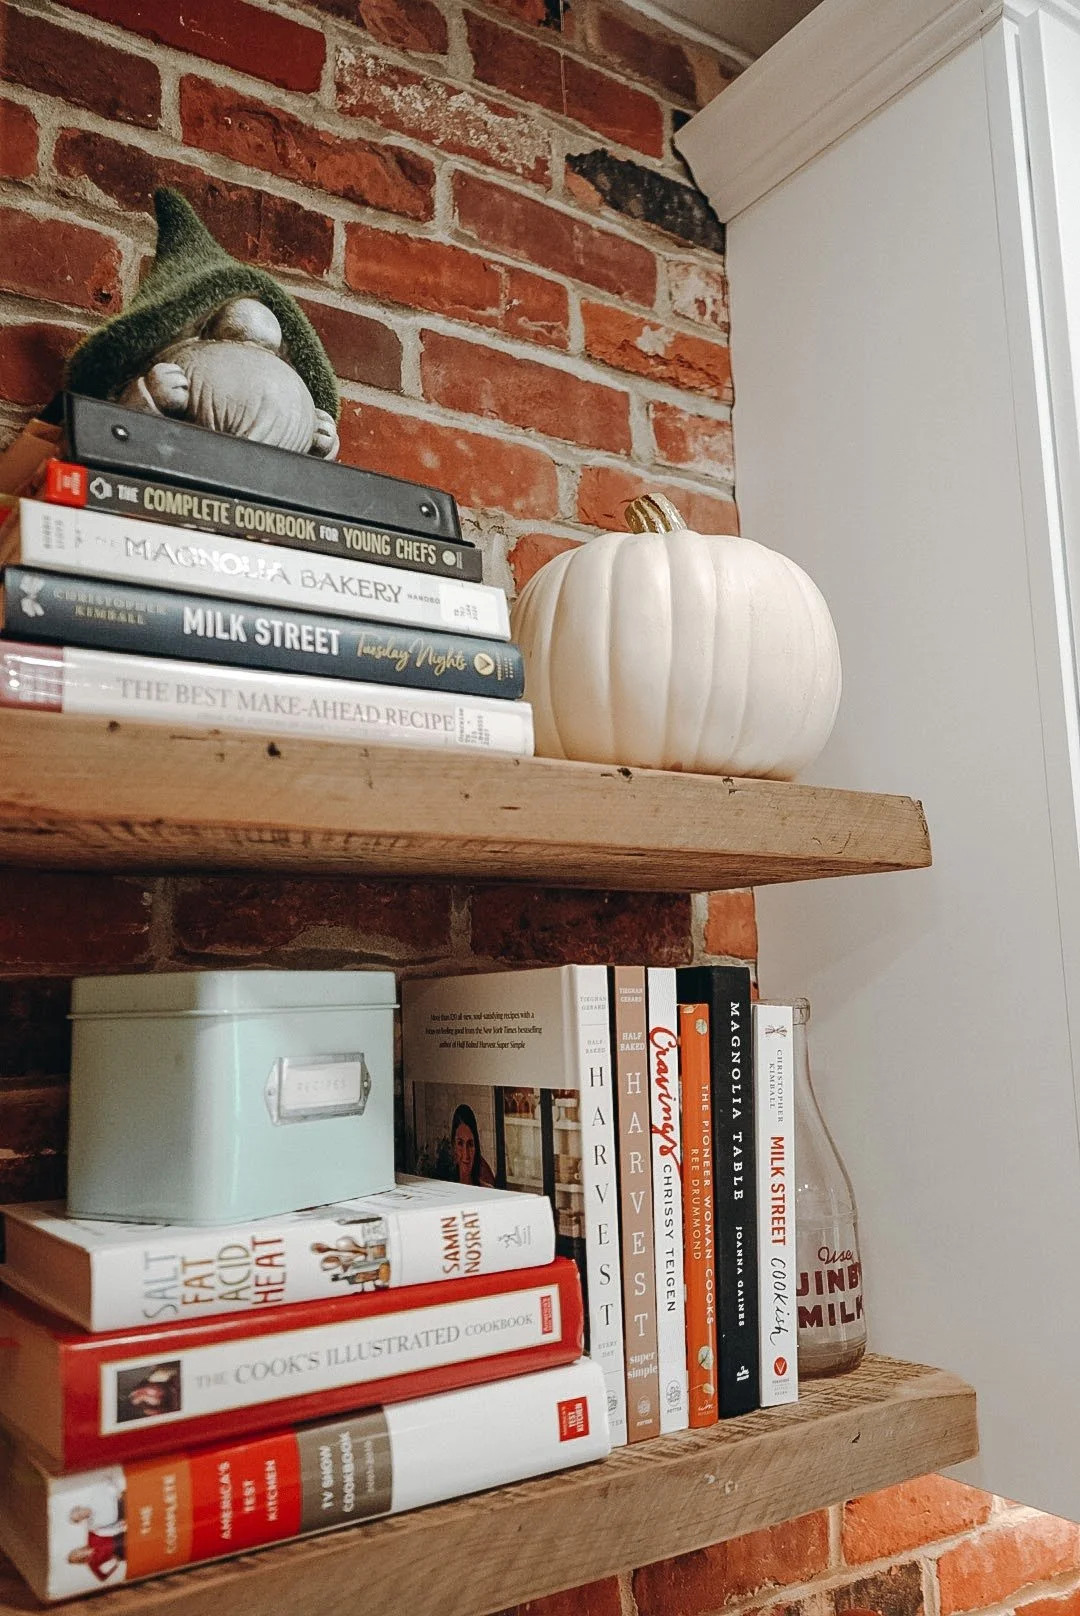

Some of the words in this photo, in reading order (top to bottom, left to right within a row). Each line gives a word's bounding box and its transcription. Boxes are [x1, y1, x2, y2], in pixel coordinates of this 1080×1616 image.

[117, 484, 139, 503] THE
[143, 486, 231, 526] COMPLETE
[234, 504, 317, 542] COOKBOOK
[319, 525, 339, 543] FOR
[342, 526, 391, 556] YOUNG
[396, 538, 437, 565] CHEFS
[125, 536, 292, 586] MAGNOLIA
[300, 569, 403, 605] BAKERY
[183, 606, 248, 643] MILK
[254, 617, 341, 656] STREET
[351, 631, 411, 672] Tuesday
[412, 637, 467, 676] Nights
[117, 677, 169, 701] THE
[176, 682, 231, 708] BEST
[238, 687, 380, 724] MAKE-AHEAD
[386, 708, 456, 732] RECIPE
[504, 1010, 520, 1021] recipes
[520, 1010, 530, 1018] with
[620, 1042, 645, 1052] BAKED
[622, 1031, 643, 1041] HALF
[730, 1002, 742, 1119] MAGNOLIA
[776, 1049, 784, 1122] CHRISTOPHER
[648, 1026, 681, 1178] Cravings
[691, 1148, 699, 1171] REE
[702, 1120, 711, 1187] PIONEER
[733, 1131, 744, 1200] TABLE
[770, 1136, 785, 1178] MILK
[589, 1066, 614, 1326] HARVEST
[626, 1072, 649, 1337] HARVEST
[663, 1164, 674, 1240] CHRISSY
[691, 1179, 701, 1260] DRUMMOND
[771, 1183, 786, 1246] STREET
[440, 1216, 461, 1274] SAMIN
[461, 1211, 482, 1274] NOSRAT
[703, 1197, 712, 1260] WOMAN
[735, 1226, 743, 1275] JOANNA
[818, 1246, 853, 1265] Use
[142, 1251, 179, 1320] SALT
[181, 1256, 216, 1305] FAT
[217, 1243, 250, 1301] ACID
[251, 1235, 288, 1305] HEAT
[665, 1247, 677, 1312] TEIGEN
[705, 1268, 714, 1325] COOKS
[737, 1280, 745, 1327] GAINES
[234, 1350, 320, 1385] COOK'S
[326, 1325, 460, 1368] ILLUSTRATED
[464, 1312, 534, 1338] COOKBOOK
[627, 1363, 658, 1380] simple
[629, 1351, 656, 1364] super
[242, 1480, 256, 1514] TEST
[265, 1459, 278, 1522] KITCHEN
[319, 1445, 334, 1489] SHOW
[339, 1430, 355, 1513] COOKBOOK
[139, 1505, 153, 1535] THE
[162, 1473, 178, 1554] COMPLETE
[216, 1460, 234, 1540] AMERICA'S
[320, 1491, 335, 1510] TV
